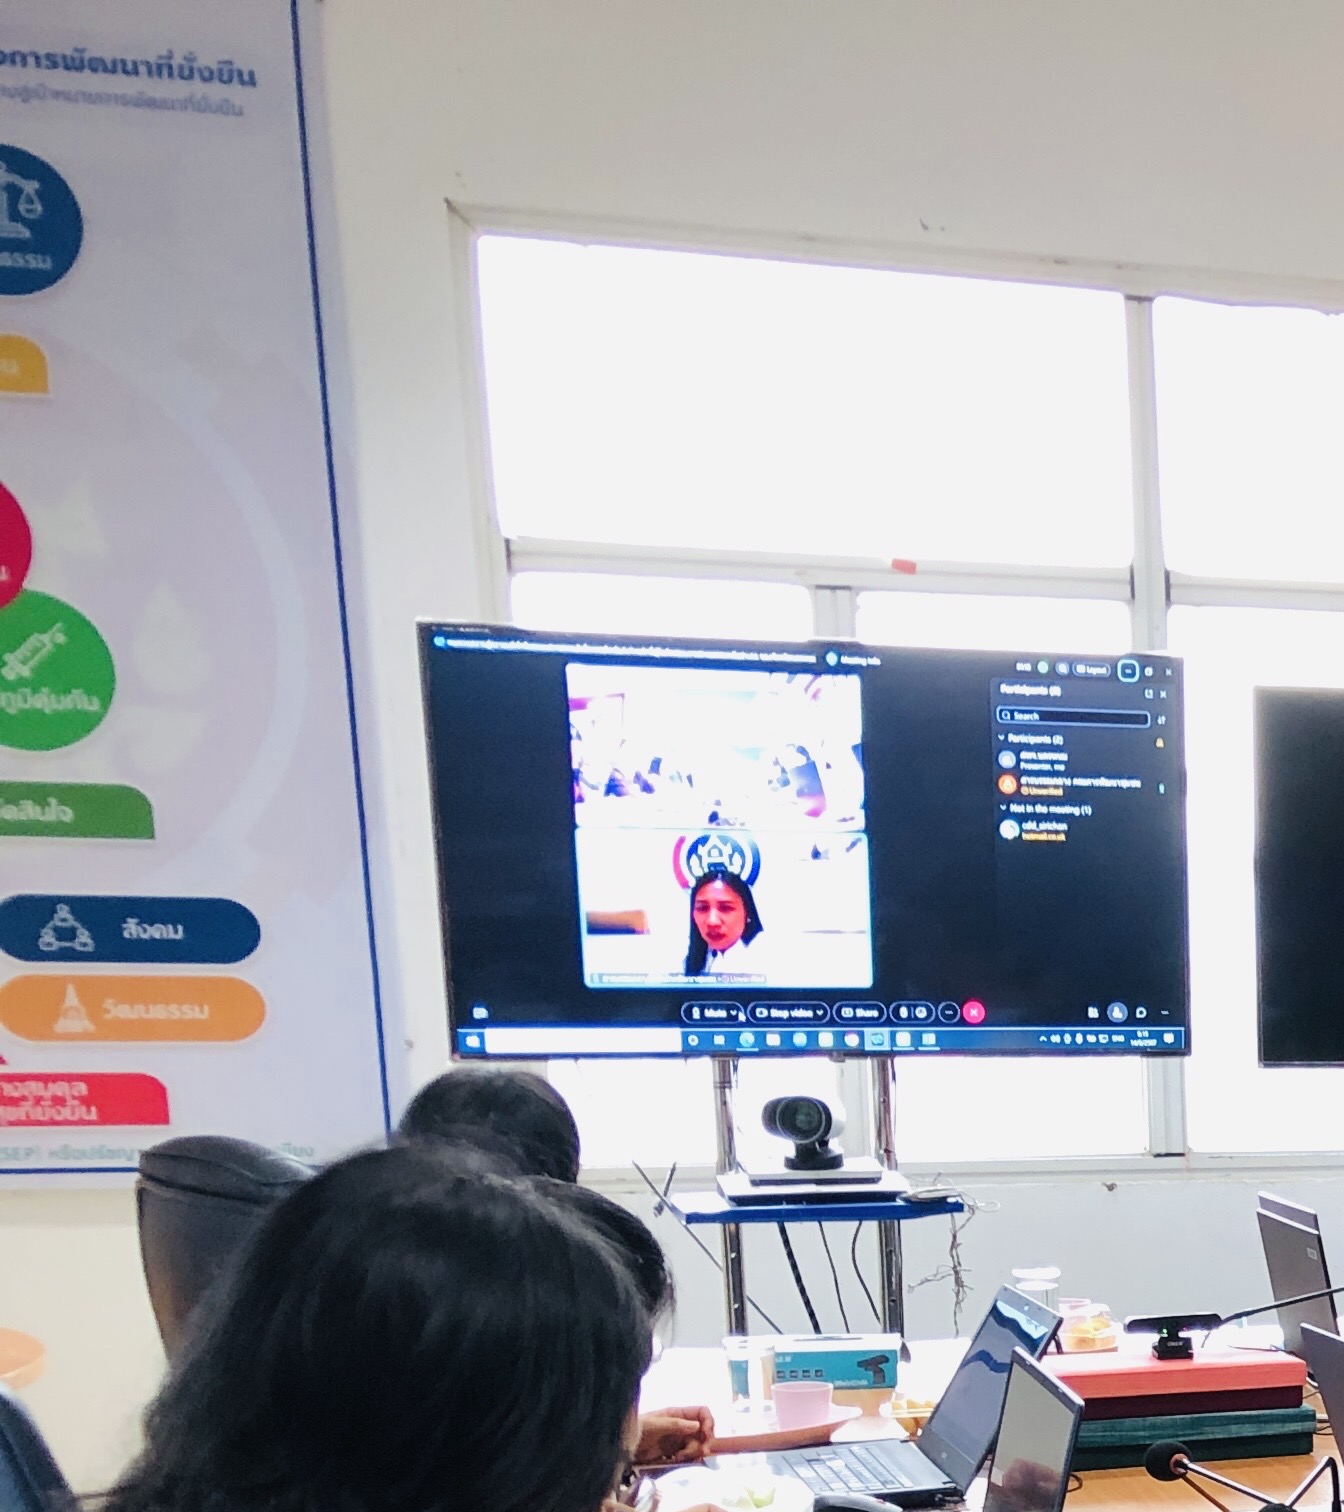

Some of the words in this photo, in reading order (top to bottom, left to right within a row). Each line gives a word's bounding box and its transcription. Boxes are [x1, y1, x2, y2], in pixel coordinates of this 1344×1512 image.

[1014, 711, 1040, 721] Search
[1008, 733, 1052, 745] Participants
[121, 917, 184, 940] สังคม
[102, 998, 210, 1020] วัฒนธรรม
